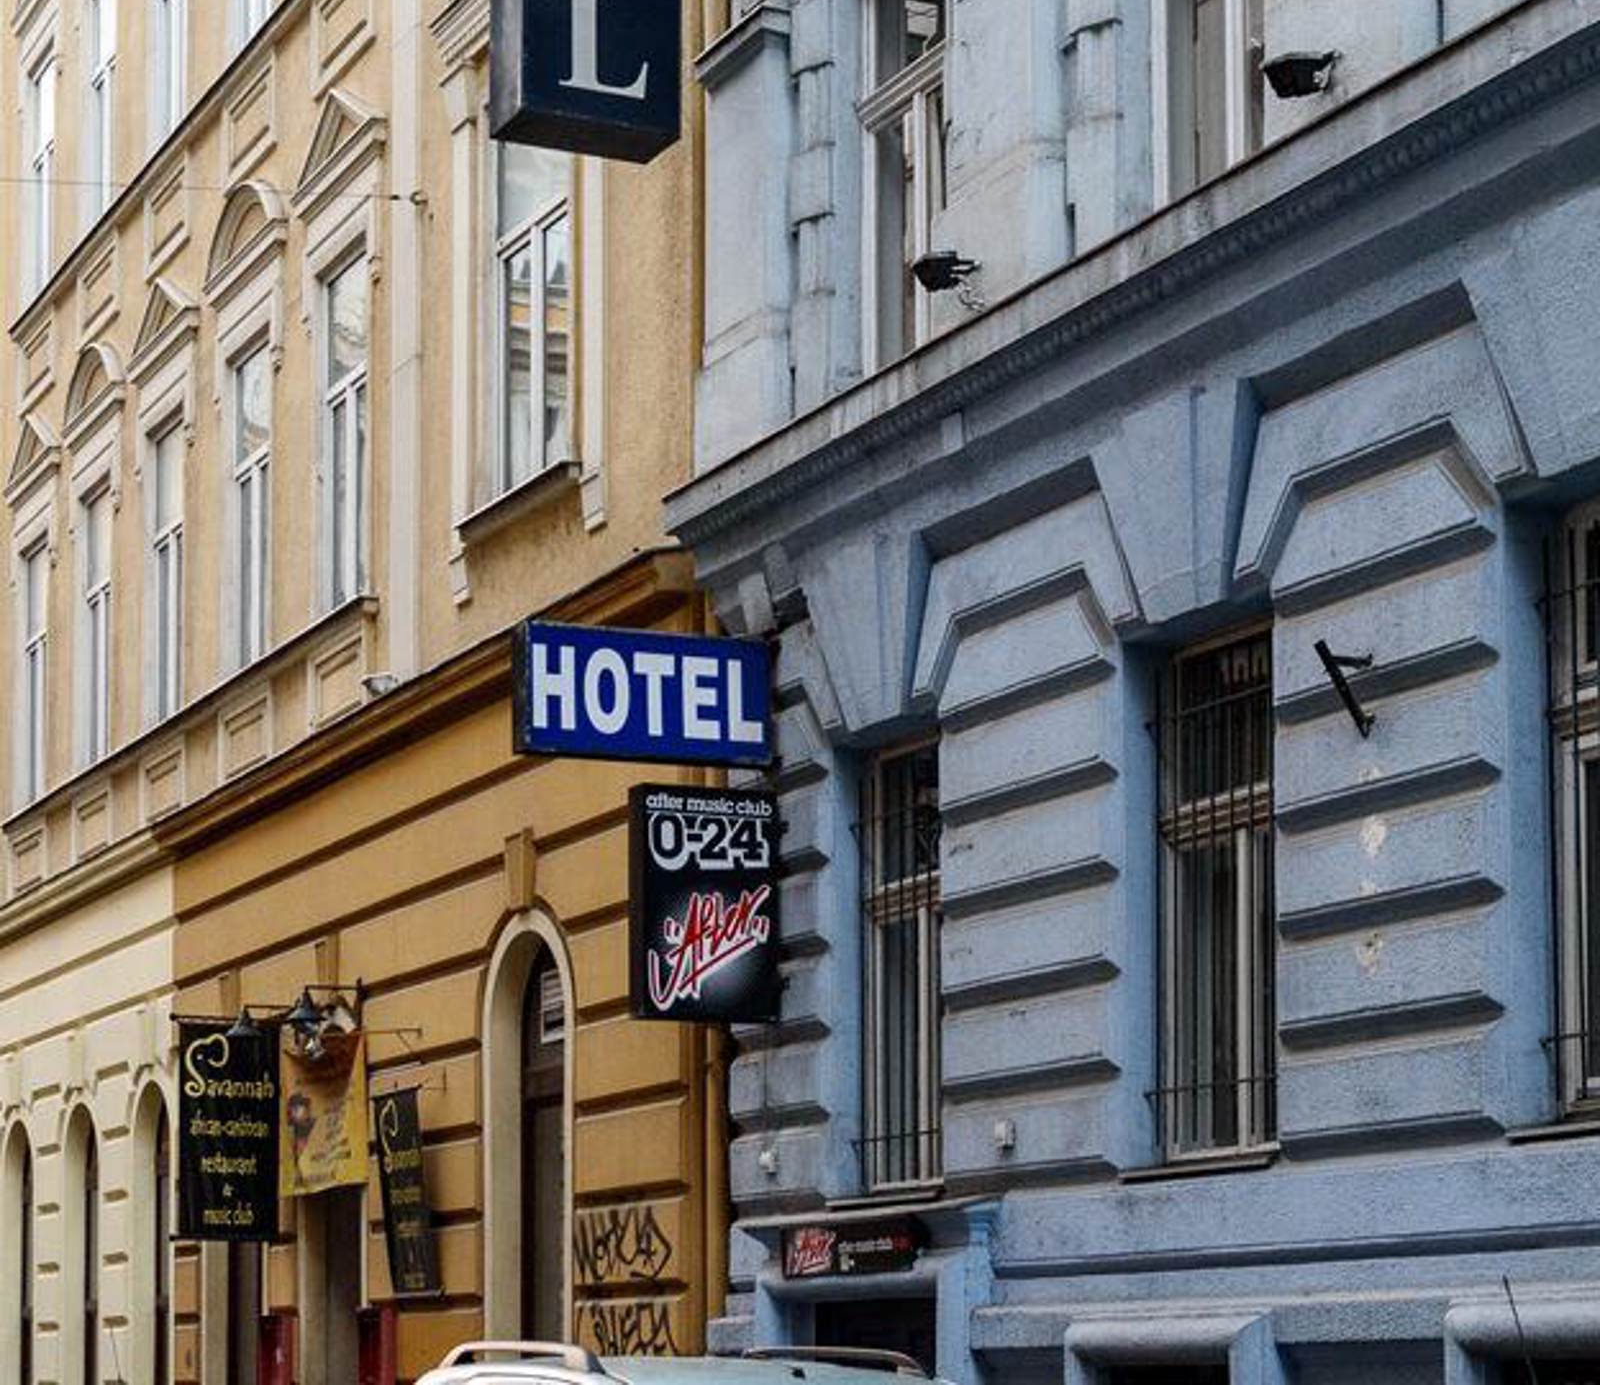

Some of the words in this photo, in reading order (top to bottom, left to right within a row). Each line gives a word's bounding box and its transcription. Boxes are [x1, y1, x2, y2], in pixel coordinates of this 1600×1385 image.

[532, 643, 764, 743] HOTEL
[646, 792, 684, 811] after
[686, 797, 734, 814] music
[735, 799, 773, 817] club
[649, 811, 770, 871] 0-24
[184, 1033, 274, 1099] Savannah
[201, 1150, 257, 1175] restaurant
[222, 1182, 234, 1197] &
